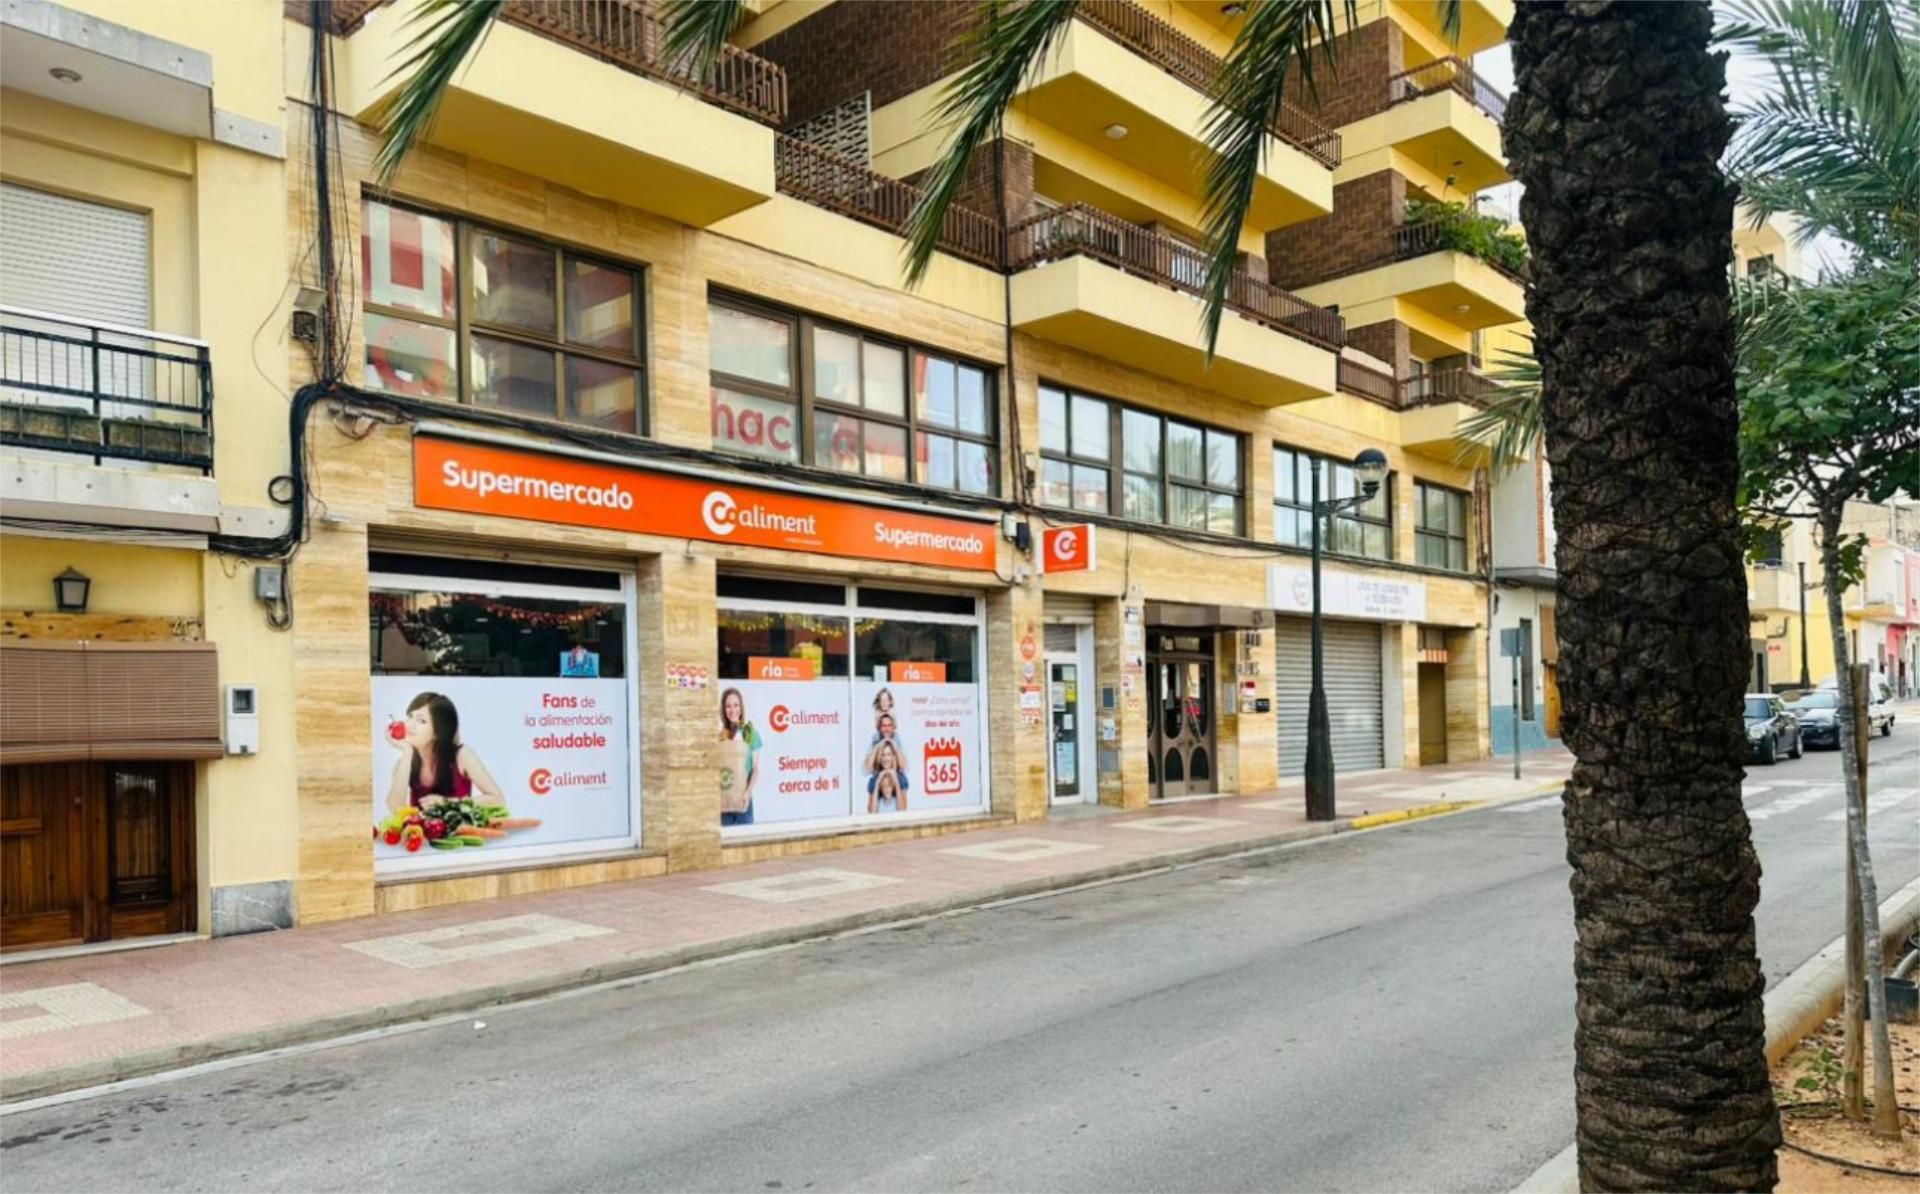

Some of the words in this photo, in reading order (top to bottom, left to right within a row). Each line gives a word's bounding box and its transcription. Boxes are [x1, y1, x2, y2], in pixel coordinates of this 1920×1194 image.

[443, 460, 634, 510] Supermercado
[874, 522, 983, 554] Supermercado
[542, 693, 577, 708] Fans
[581, 696, 596, 708] de
[525, 714, 536, 727] la
[539, 713, 612, 727] alimentación
[533, 732, 606, 749] saludable
[778, 756, 827, 773] Siempre
[929, 763, 958, 784] 365
[778, 778, 811, 793] cerca
[815, 776, 829, 790] de
[832, 775, 840, 789] ti
